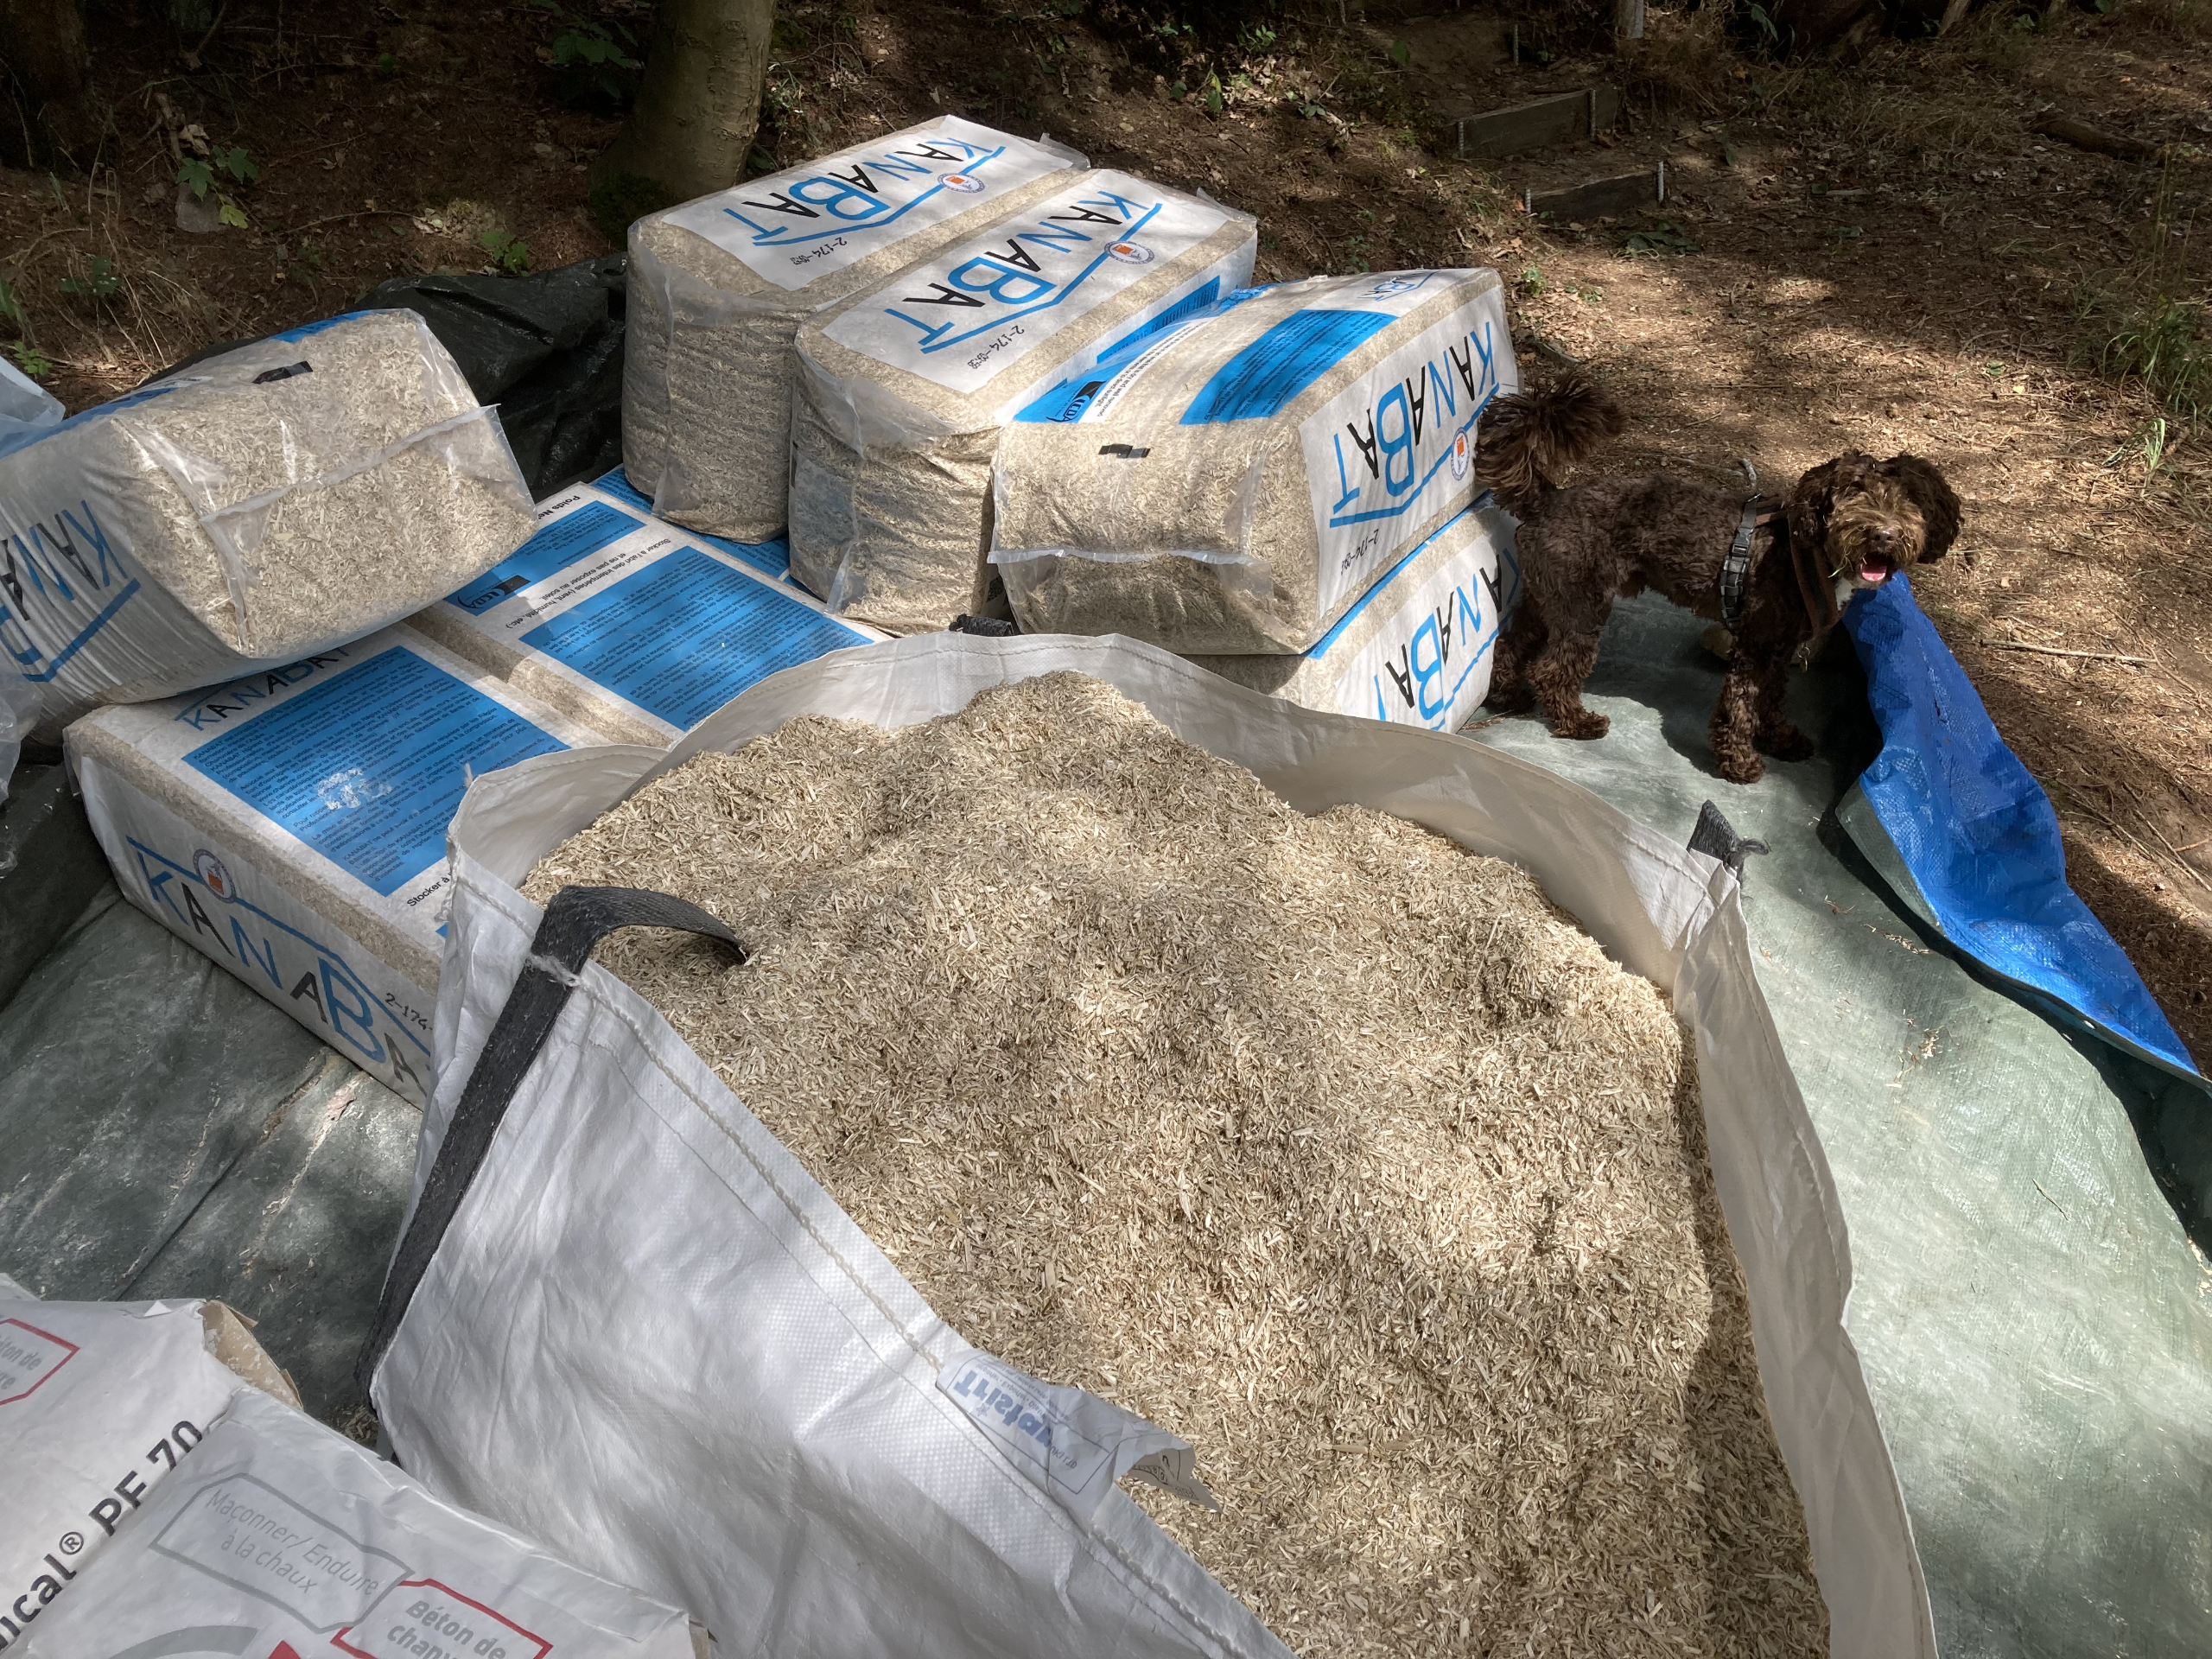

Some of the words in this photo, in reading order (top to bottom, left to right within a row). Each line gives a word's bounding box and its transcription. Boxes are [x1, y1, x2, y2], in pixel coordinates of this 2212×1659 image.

[724, 137, 993, 240] KANABAT
[884, 191, 1149, 346] KANABAT
[1333, 321, 1496, 514] KANABAT
[551, 495, 582, 510] Poids
[568, 566, 596, 585] exposer
[572, 566, 613, 592] intempéries
[594, 560, 609, 570] pas
[612, 561, 626, 571] des
[406, 880, 442, 907] Stocker
[137, 851, 431, 1098] KANABA
[18, 1351, 41, 1371] de
[89, 1470, 147, 1537] PF
[146, 1420, 203, 1471] 70
[221, 1529, 236, 1552] à
[238, 1538, 255, 1559] la
[255, 1548, 318, 1595] chaux
[302, 1543, 378, 1596] Enduire
[405, 1600, 474, 1645] Béton
[474, 1638, 505, 1659] de
